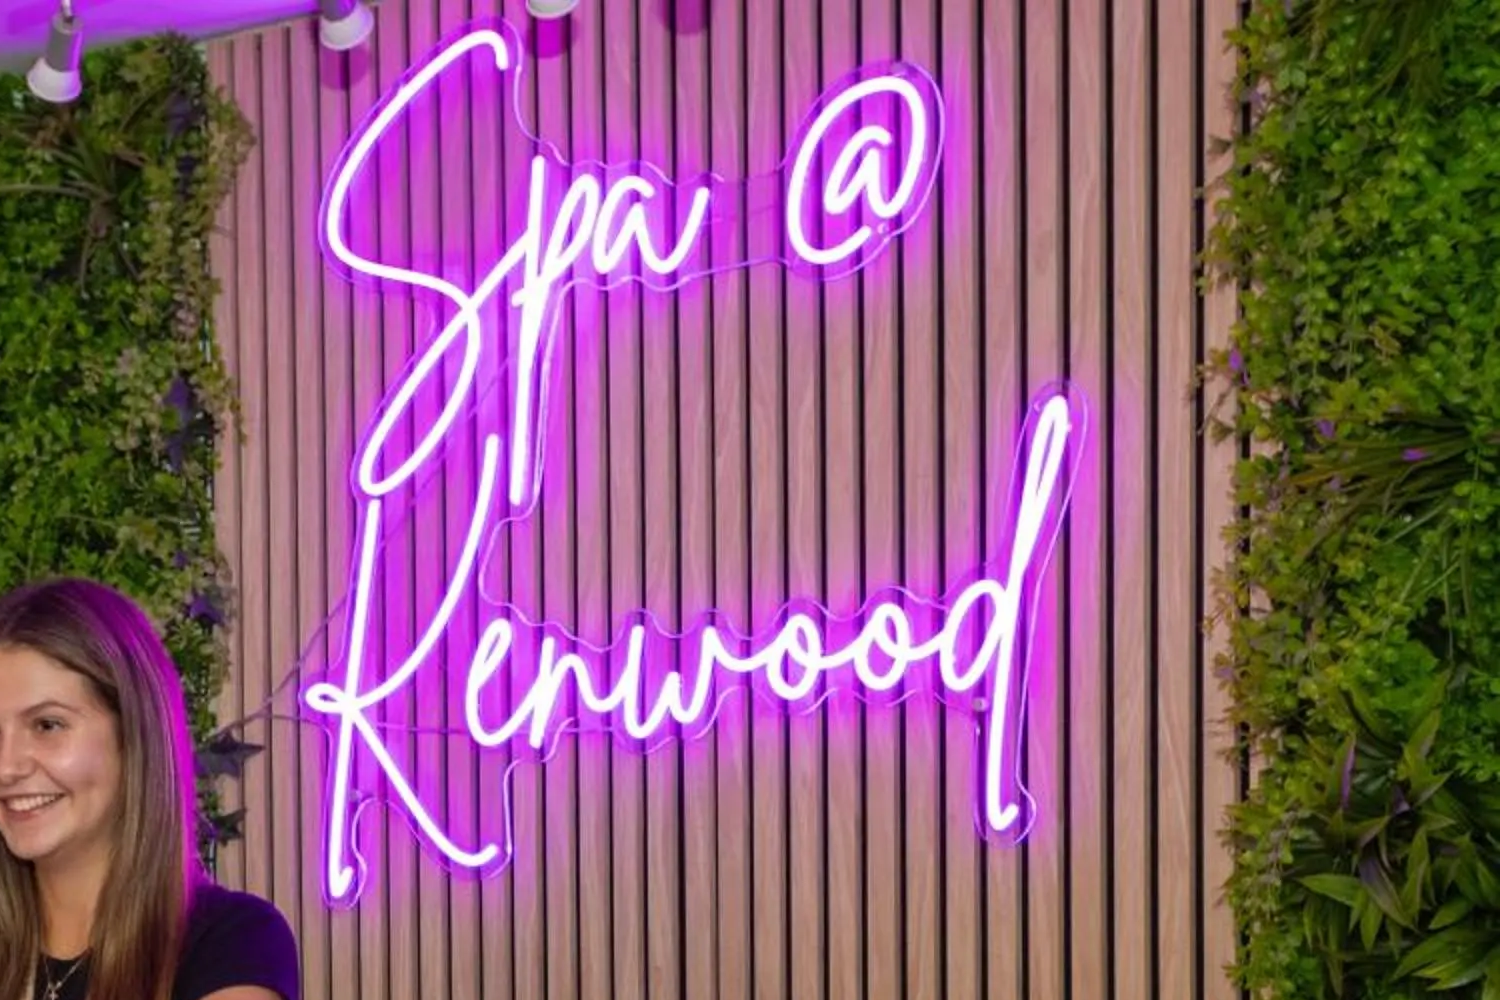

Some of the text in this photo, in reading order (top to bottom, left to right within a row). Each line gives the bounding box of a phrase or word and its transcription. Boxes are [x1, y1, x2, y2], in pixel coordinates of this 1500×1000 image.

[326, 30, 928, 506] Spa @
[305, 395, 1070, 900] Kenwood
